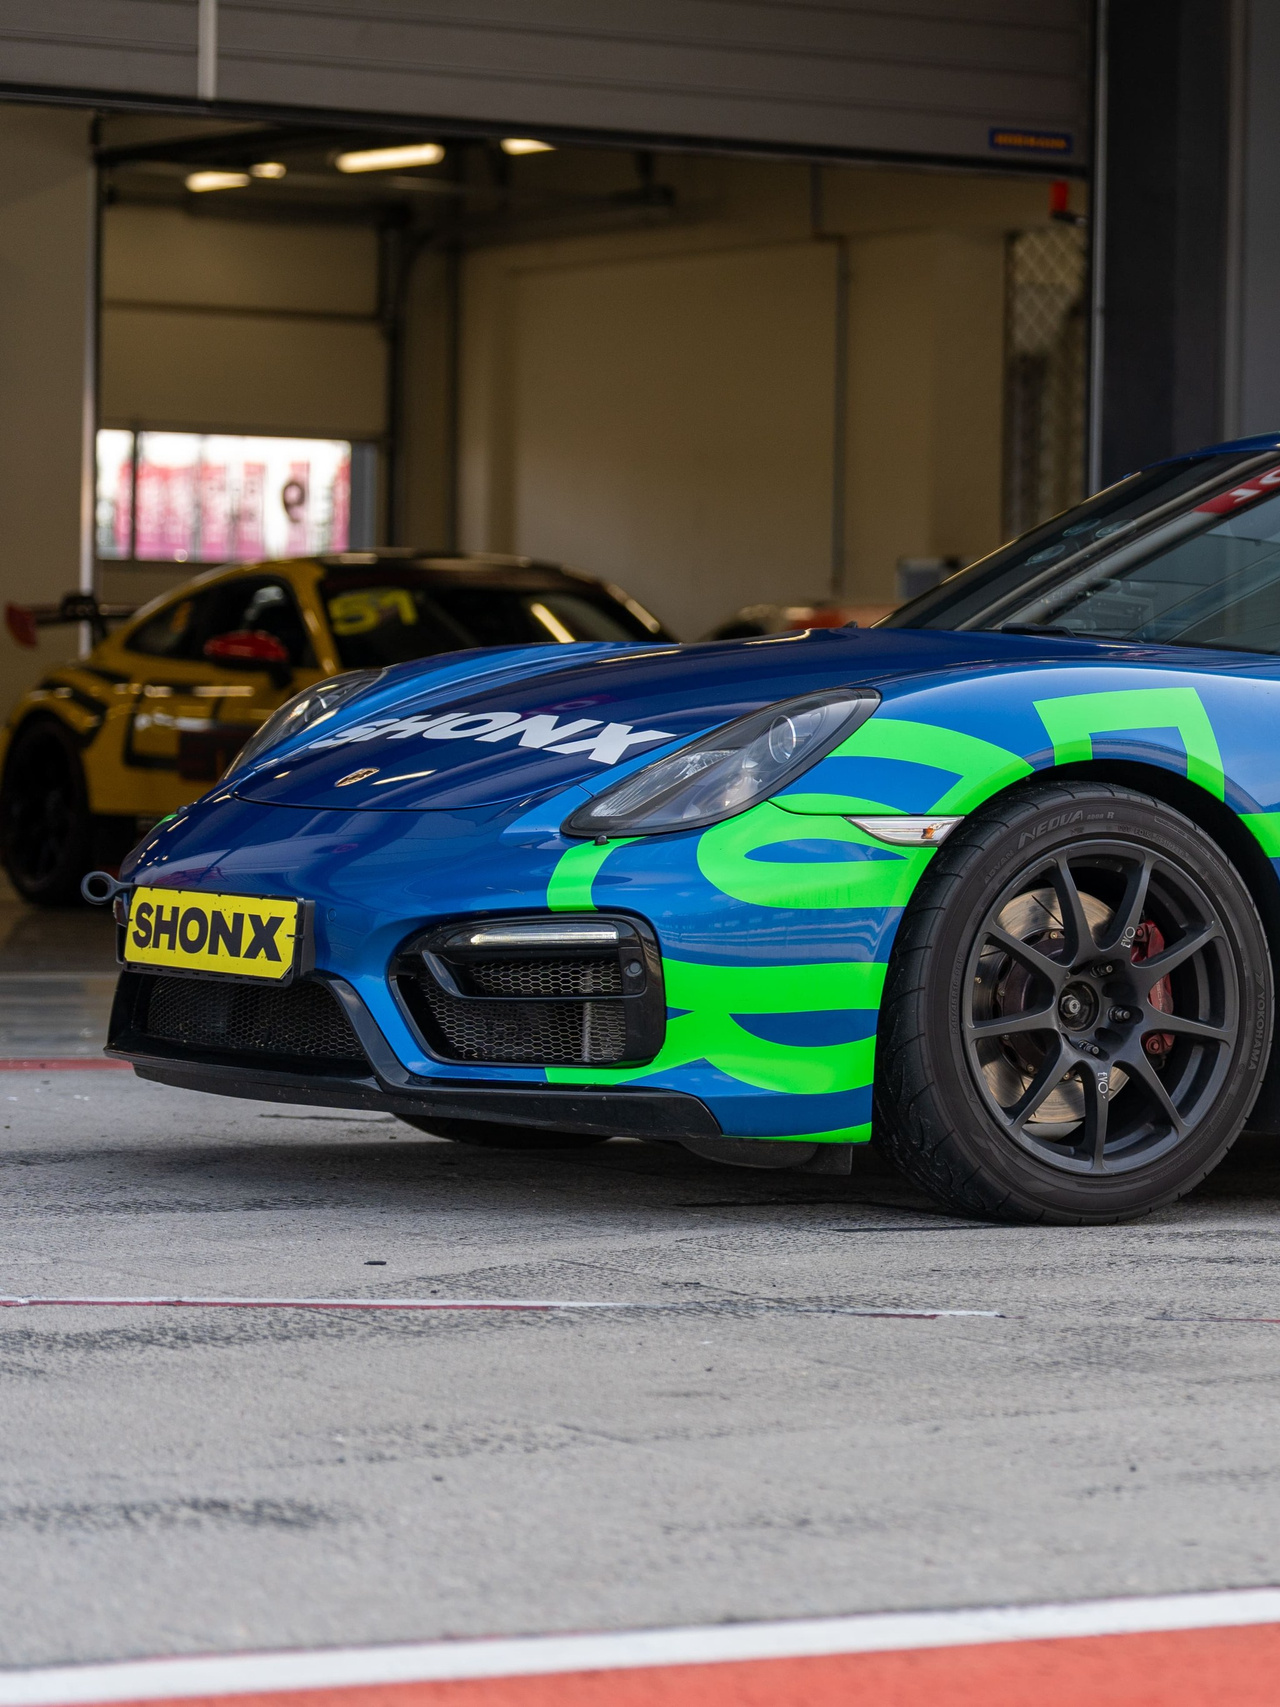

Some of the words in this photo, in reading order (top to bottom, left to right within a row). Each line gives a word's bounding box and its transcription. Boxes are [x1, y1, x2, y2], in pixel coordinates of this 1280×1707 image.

[308, 712, 677, 765] SHONX
[1017, 810, 1084, 850] NEOVA
[132, 901, 285, 963] SHONX
[1120, 926, 1136, 949] EVO
[1247, 990, 1266, 1071] YOKOHAMA
[1097, 1071, 1109, 1094] EVO
